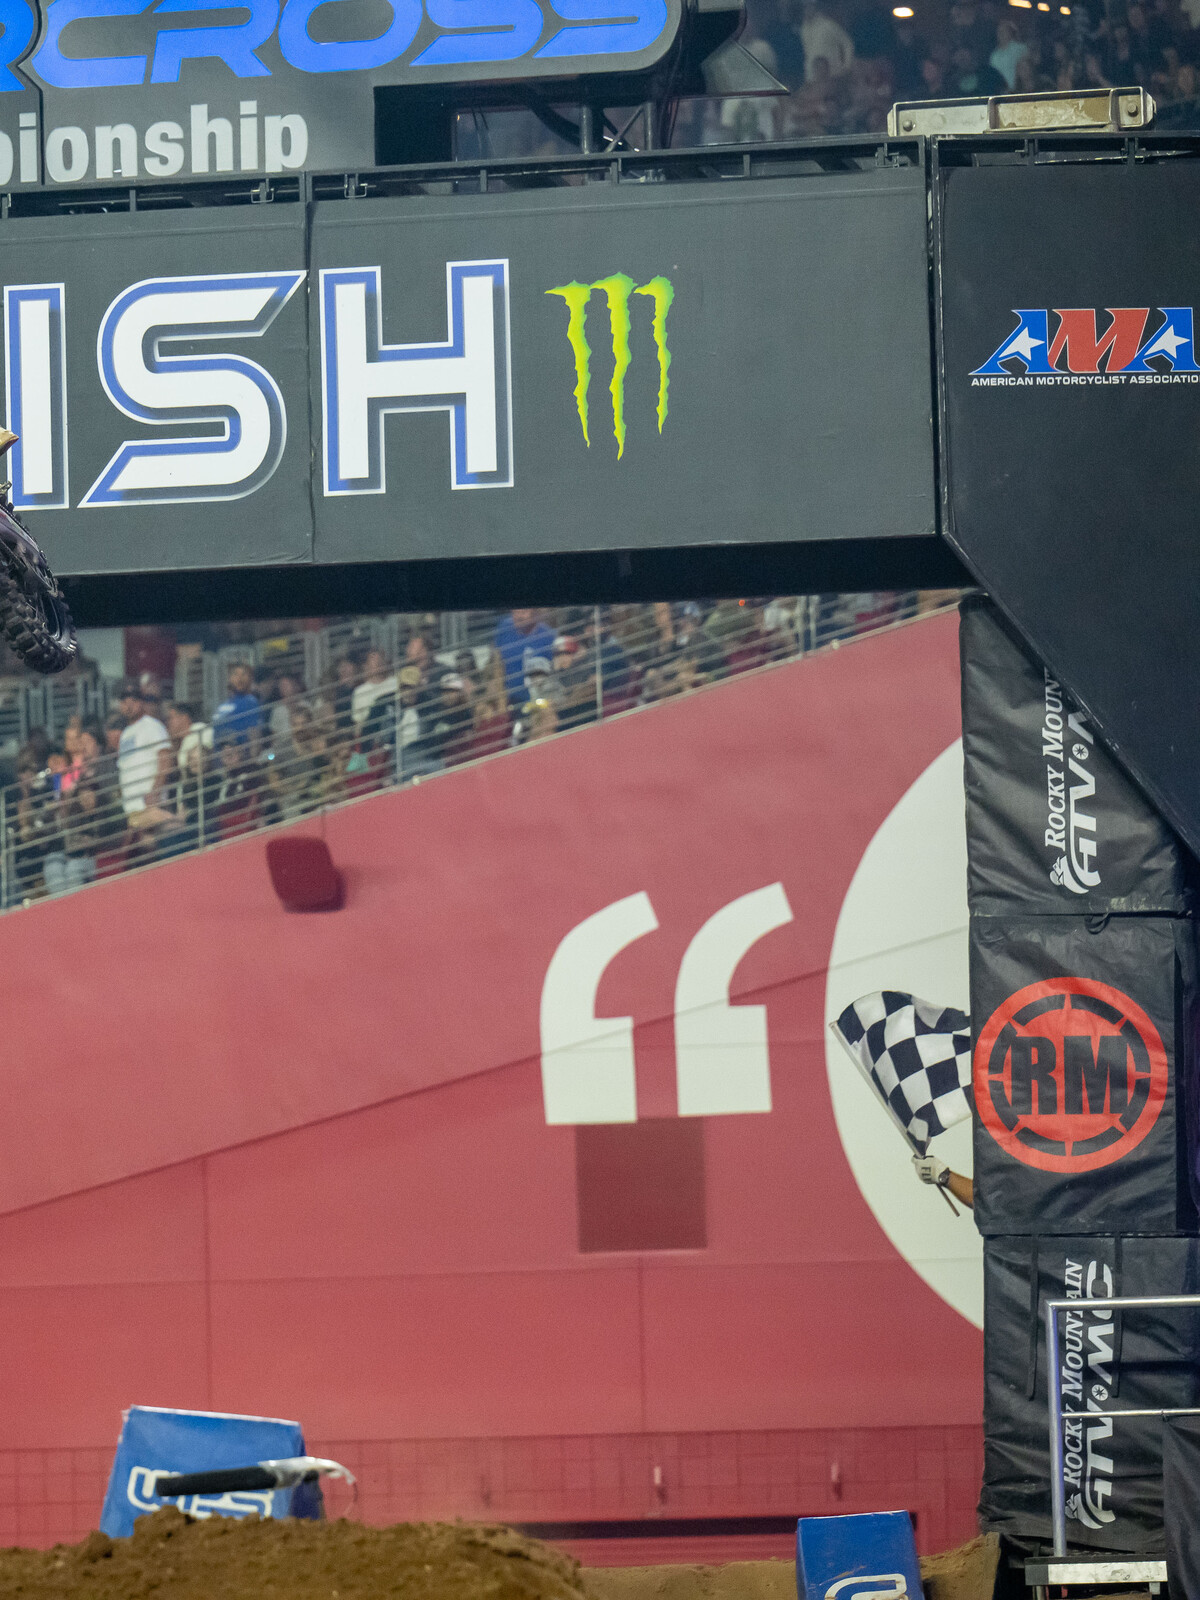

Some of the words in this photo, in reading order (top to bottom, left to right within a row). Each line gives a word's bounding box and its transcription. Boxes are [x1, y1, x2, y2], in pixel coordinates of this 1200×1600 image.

[968, 306, 1200, 376] AMA
[971, 377, 1034, 387] AMERICAN
[1036, 375, 1127, 386] MOTORCYCLIST
[1045, 764, 1066, 851] ROCKY
[1063, 1404, 1083, 1489] ROCKY
